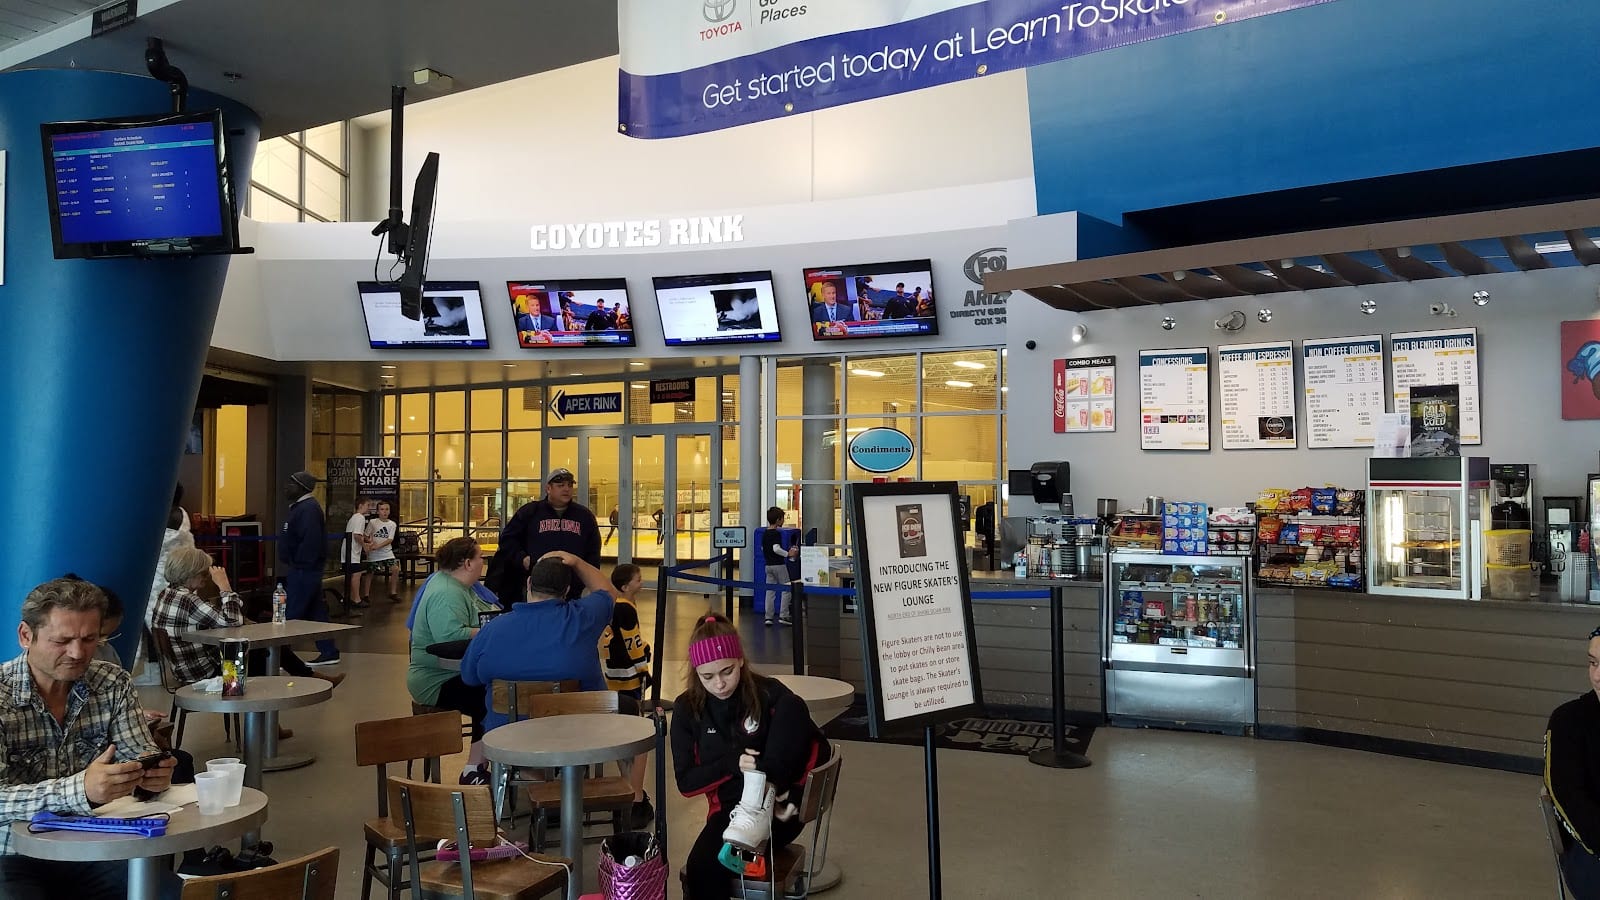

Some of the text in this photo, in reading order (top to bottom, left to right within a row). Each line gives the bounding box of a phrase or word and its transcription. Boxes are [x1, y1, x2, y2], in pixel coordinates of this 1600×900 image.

[760, 4, 807, 24] Places
[700, 21, 742, 40] TOYOTA
[703, 79, 742, 108] Get
[748, 55, 835, 100] started
[842, 44, 927, 72] today
[934, 32, 963, 61] at
[531, 214, 744, 250] COYOTES RINK
[950, 309, 986, 328] DIRECTV
[975, 317, 993, 335] COX
[1309, 344, 1375, 357] NON COFFEE DRINKS
[1393, 337, 1472, 351] ICED BLENDED DRINKS
[1153, 356, 1192, 367] CONCESSIONS
[1220, 350, 1290, 363] COFFEE AND ESPRESSO
[656, 381, 690, 391] RESTROOMS
[565, 397, 617, 411] APEX RINK
[364, 458, 393, 468] PLAY
[357, 467, 399, 477] WATCH
[360, 476, 397, 486] SHARE
[539, 518, 581, 536] ARIZONA
[880, 561, 949, 576] INTRODUCING THE
[873, 576, 958, 593] NEW FIGURE SKATER'S
[902, 594, 935, 607] LOUNGE
[624, 634, 643, 650] 72
[881, 639, 900, 648] Figure
[901, 636, 923, 645] Skaters
[934, 632, 944, 640] not
[882, 653, 893, 661] the
[893, 650, 911, 659] lobby
[919, 646, 935, 655] Chilly
[936, 644, 951, 652] Bean
[898, 664, 908, 673] put
[909, 660, 928, 669] skates
[945, 656, 960, 664] store
[892, 667, 961, 686] skate bags. The Skater's
[887, 690, 909, 701] Lounge
[910, 688, 915, 696] is
[916, 685, 937, 695] always
[937, 680, 962, 692] required
[914, 695, 946, 709] be utilized.
